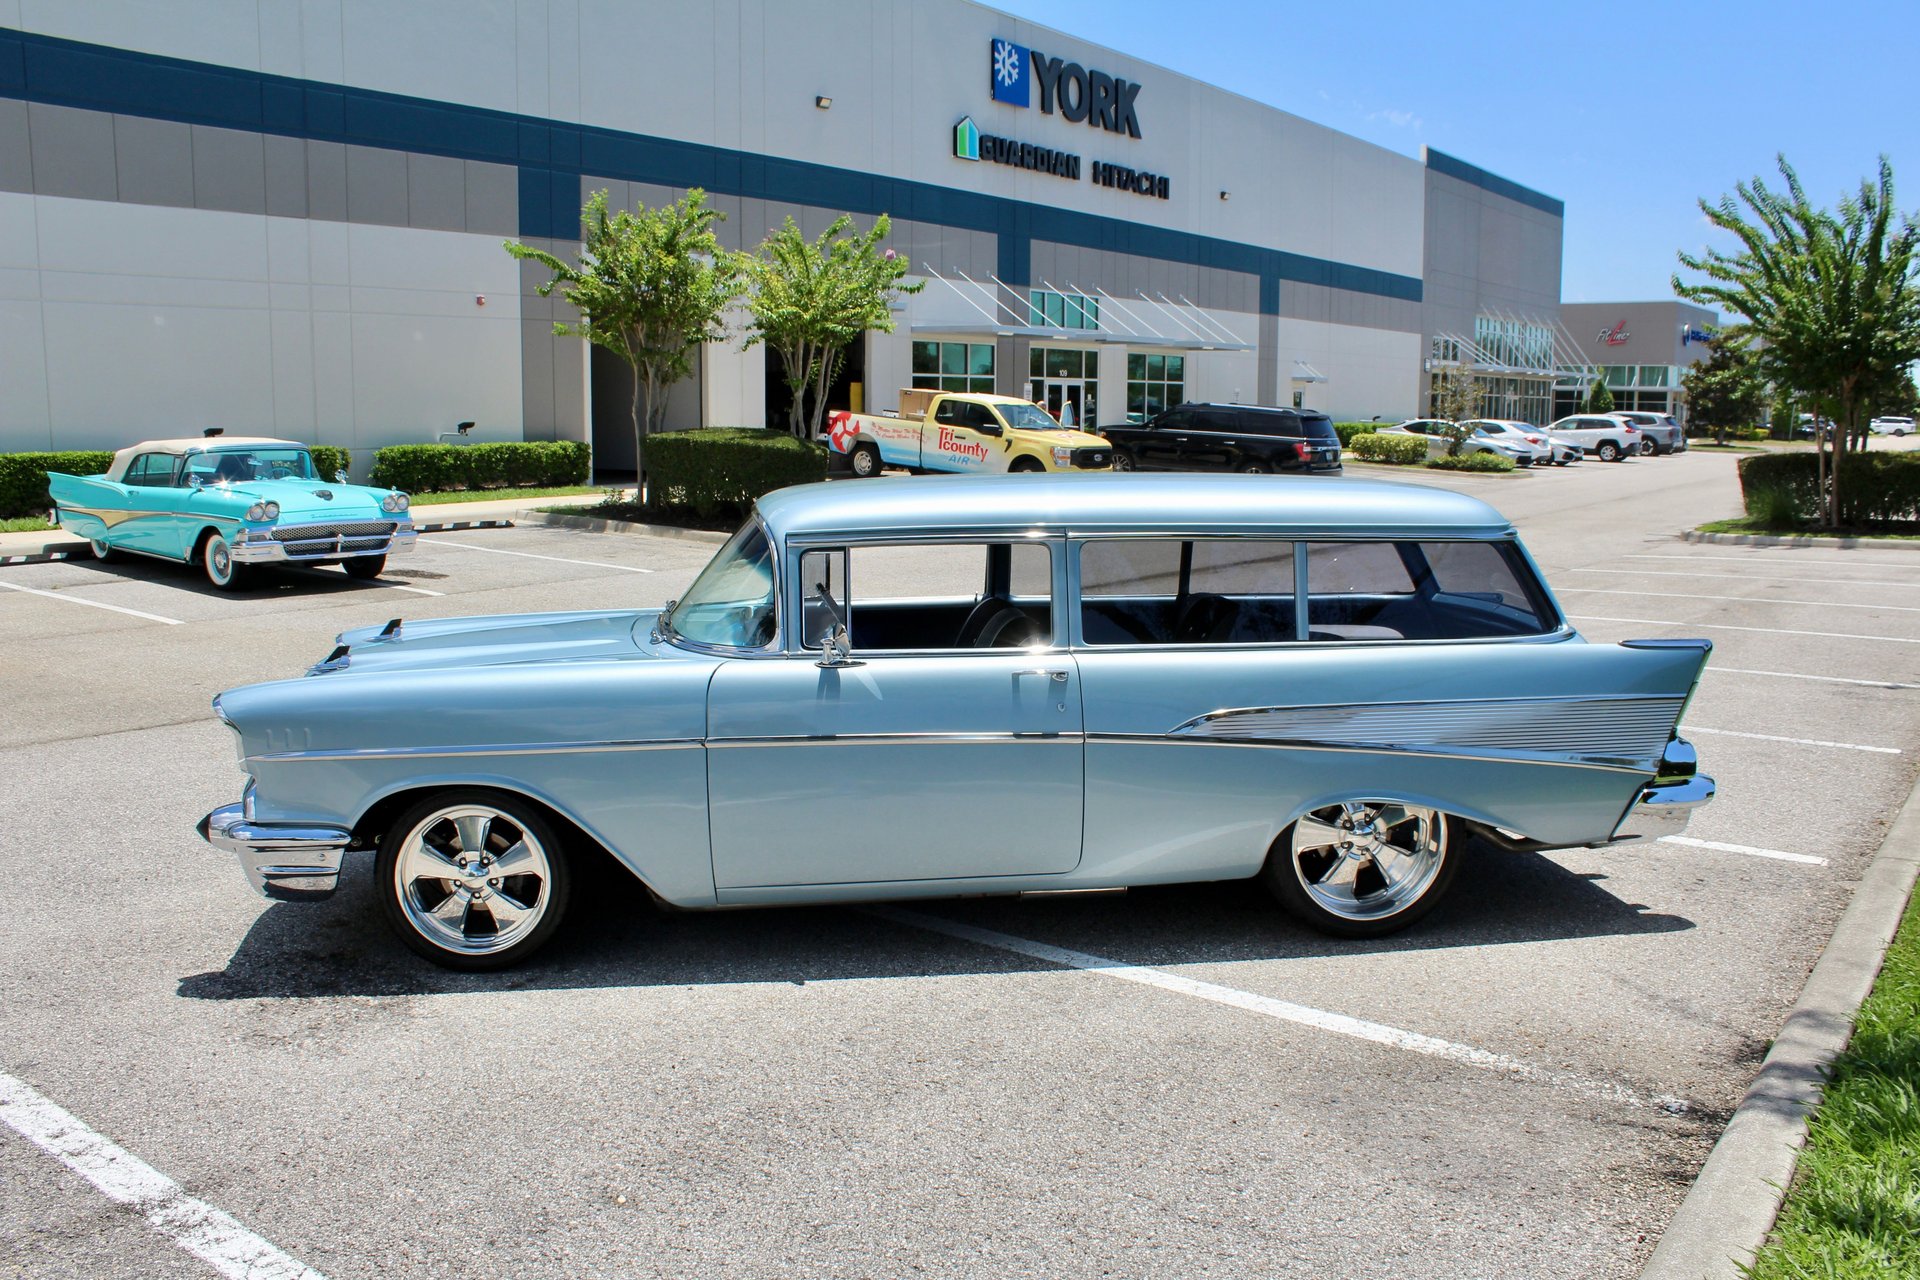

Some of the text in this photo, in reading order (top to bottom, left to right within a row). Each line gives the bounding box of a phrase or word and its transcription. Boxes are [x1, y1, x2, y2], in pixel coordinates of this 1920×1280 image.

[1031, 50, 1142, 139] YORK
[979, 134, 1080, 180] GUARDIAN
[1092, 160, 1170, 200] HITACHI
[943, 440, 988, 462] county
[949, 454, 970, 465] AIR
